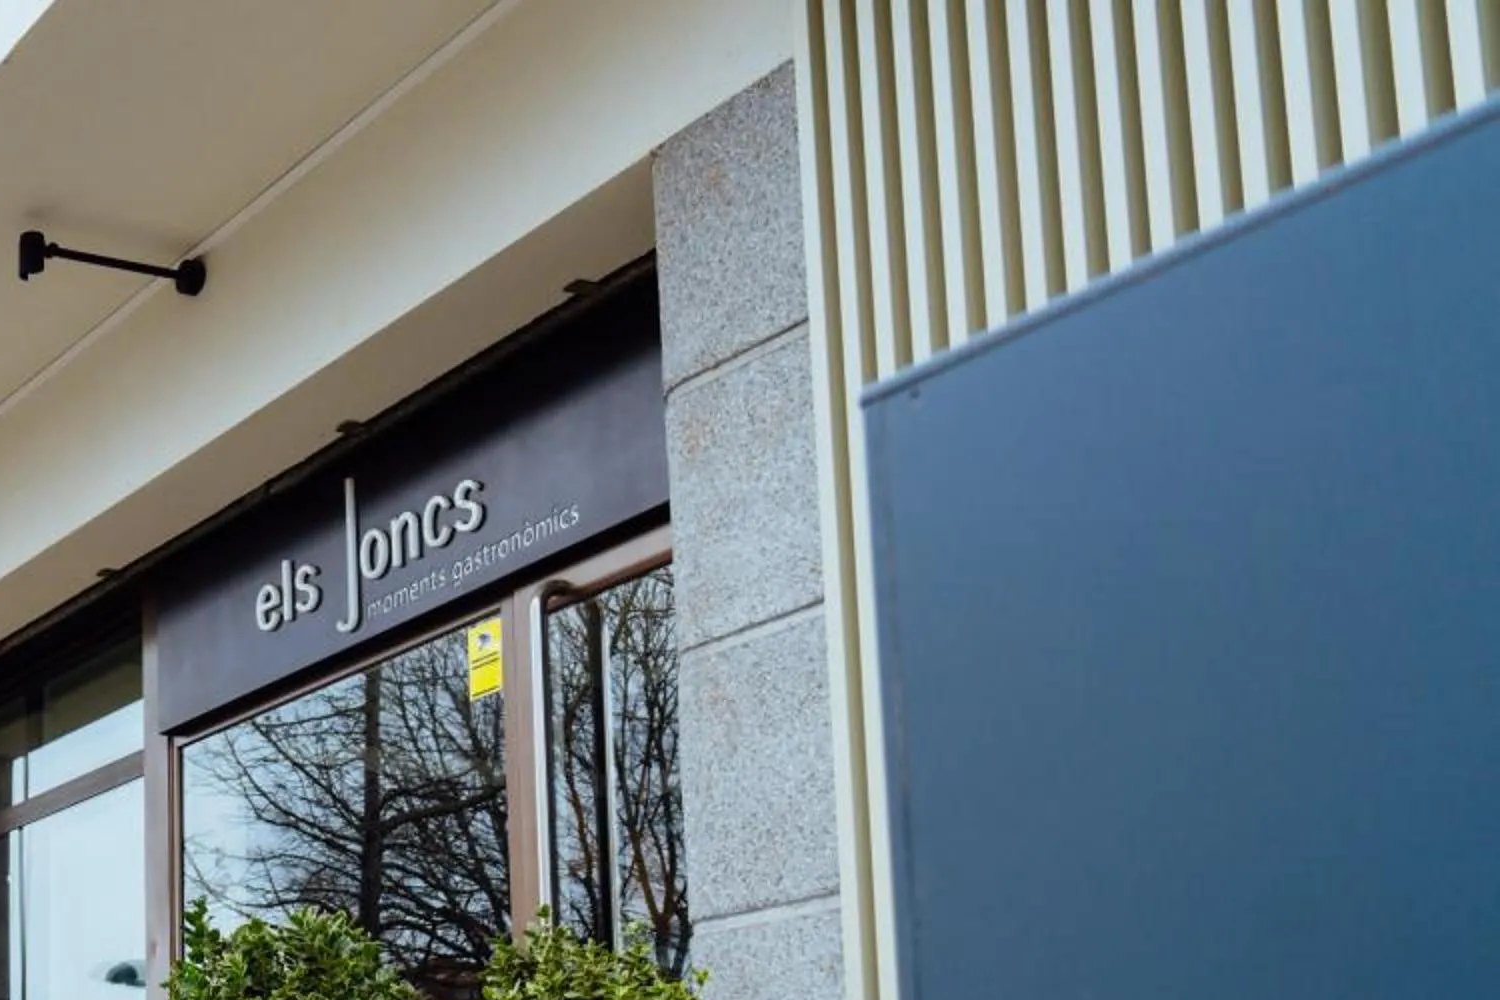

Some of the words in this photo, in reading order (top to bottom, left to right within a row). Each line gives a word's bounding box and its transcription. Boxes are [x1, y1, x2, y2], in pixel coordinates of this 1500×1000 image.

[256, 560, 321, 632] els
[366, 566, 446, 618] moments
[452, 503, 580, 588] gastronòmics
